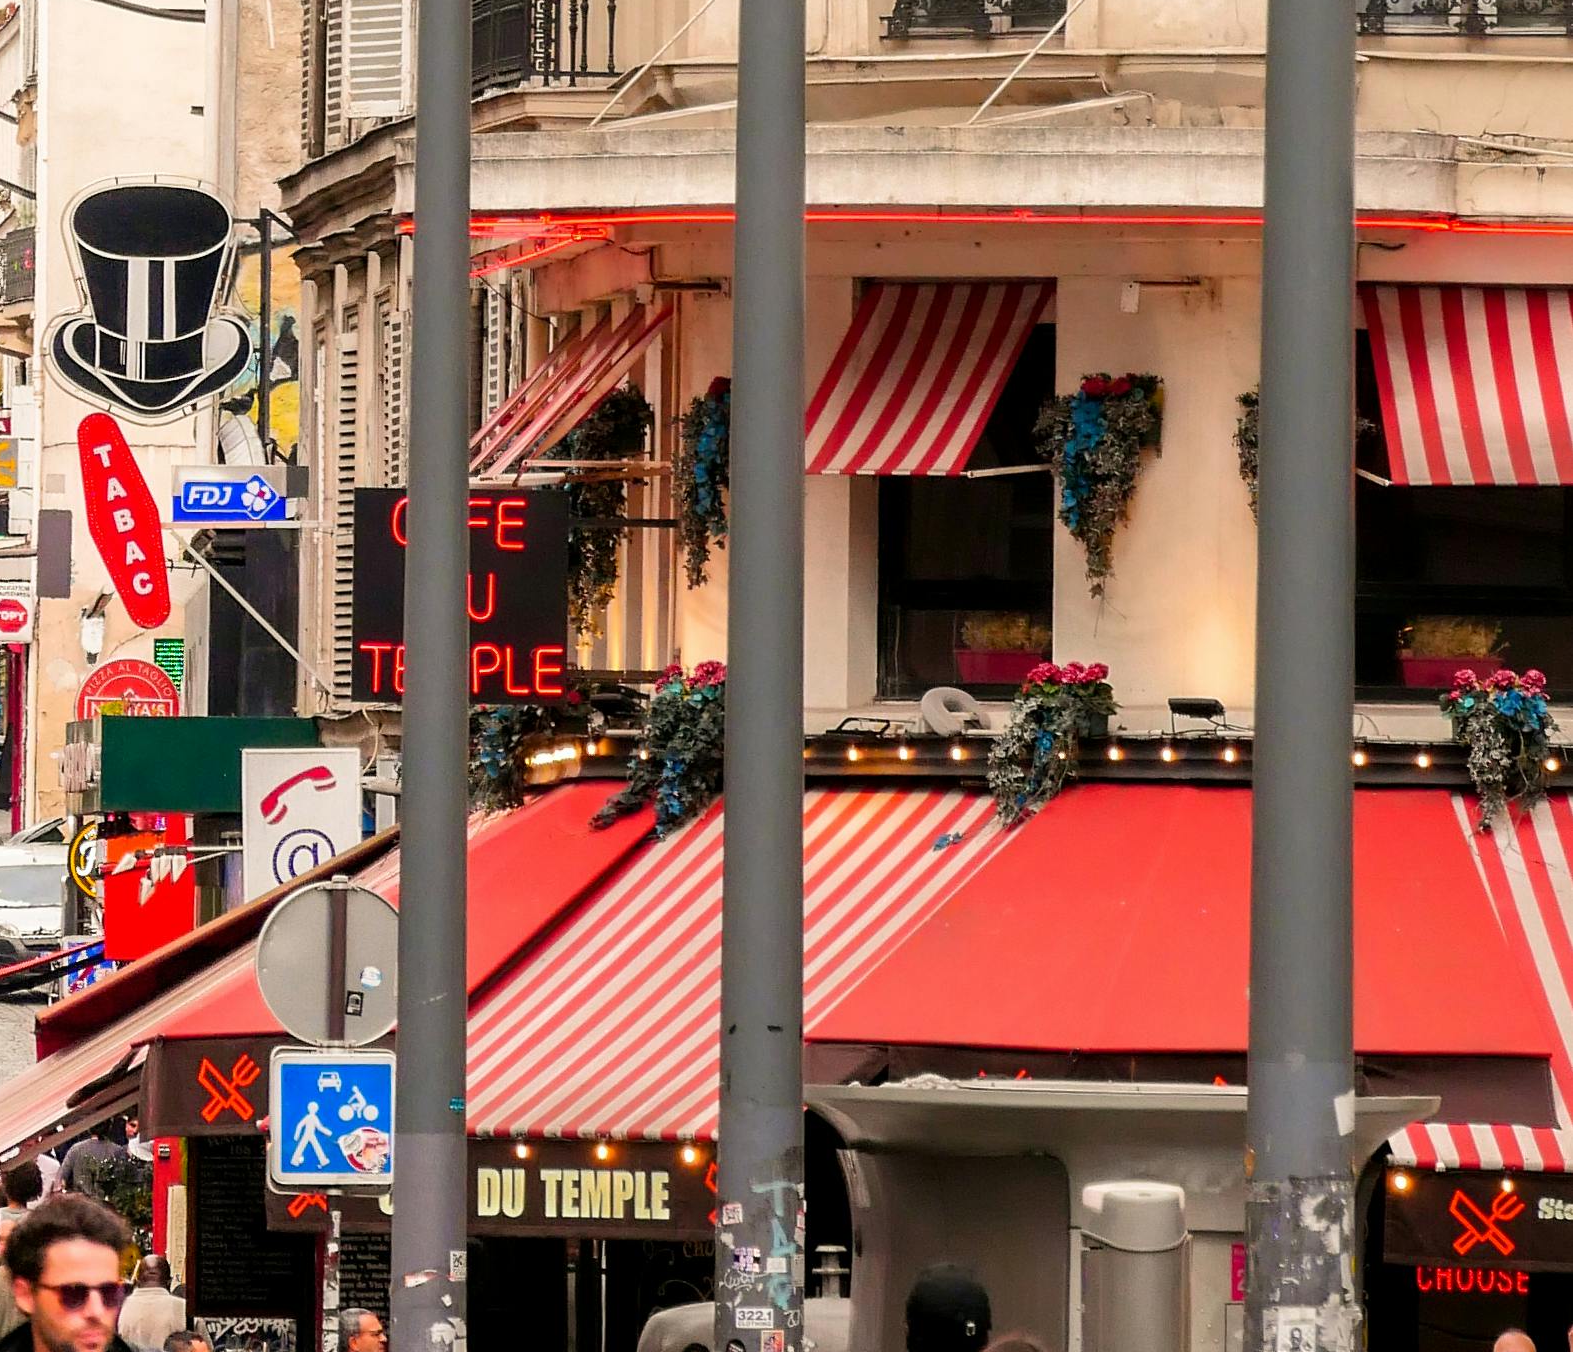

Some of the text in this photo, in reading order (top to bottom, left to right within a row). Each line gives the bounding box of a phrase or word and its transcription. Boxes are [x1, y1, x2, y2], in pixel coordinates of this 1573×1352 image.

[93, 443, 154, 595] TABAC
[187, 486, 232, 505] FDJ
[466, 573, 495, 621] U
[85, 663, 172, 696] PIZZA AL TAGLIO
[359, 644, 564, 694] TEPLE
[477, 1167, 670, 1220] DU TEMPLE
[738, 1310, 773, 1321] 322.1
